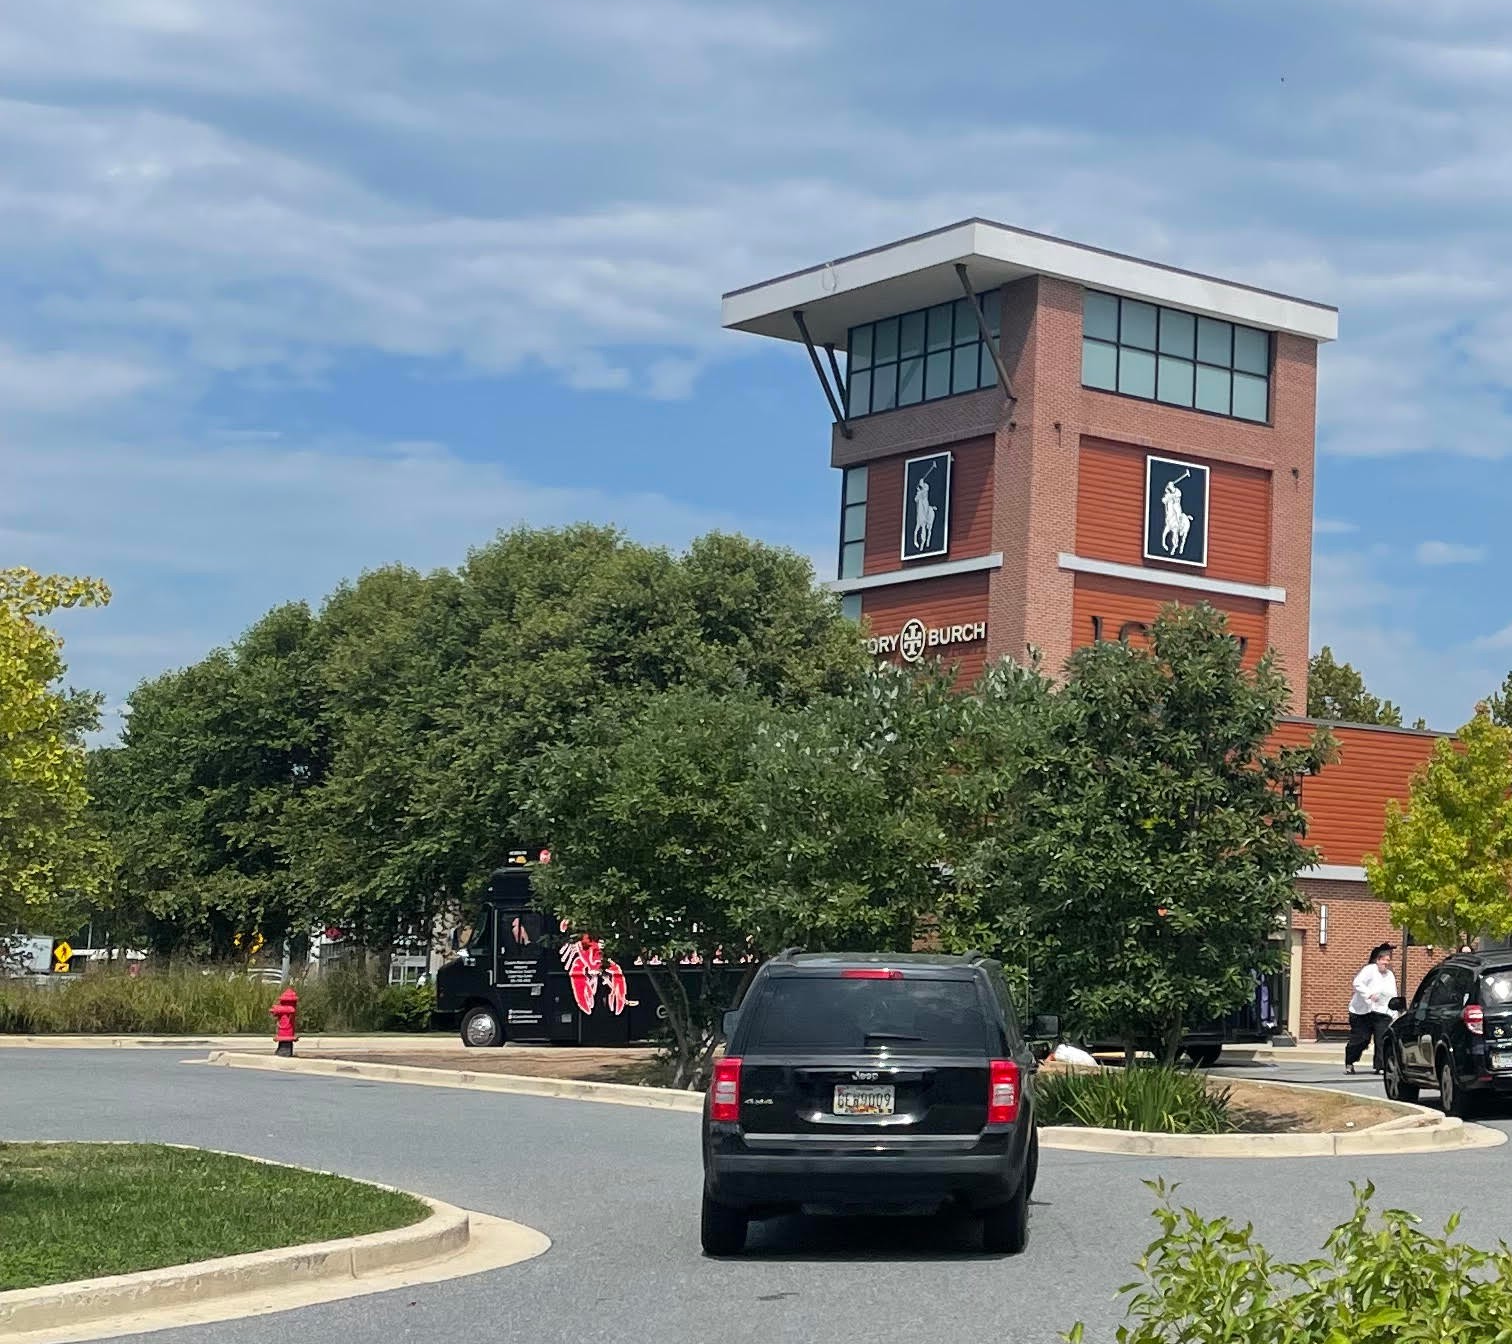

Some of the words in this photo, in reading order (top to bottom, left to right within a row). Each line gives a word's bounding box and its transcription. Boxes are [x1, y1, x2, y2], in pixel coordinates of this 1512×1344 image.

[861, 633, 900, 655] ORY
[928, 621, 986, 646] BURCH
[851, 1070, 879, 1081] Jeep
